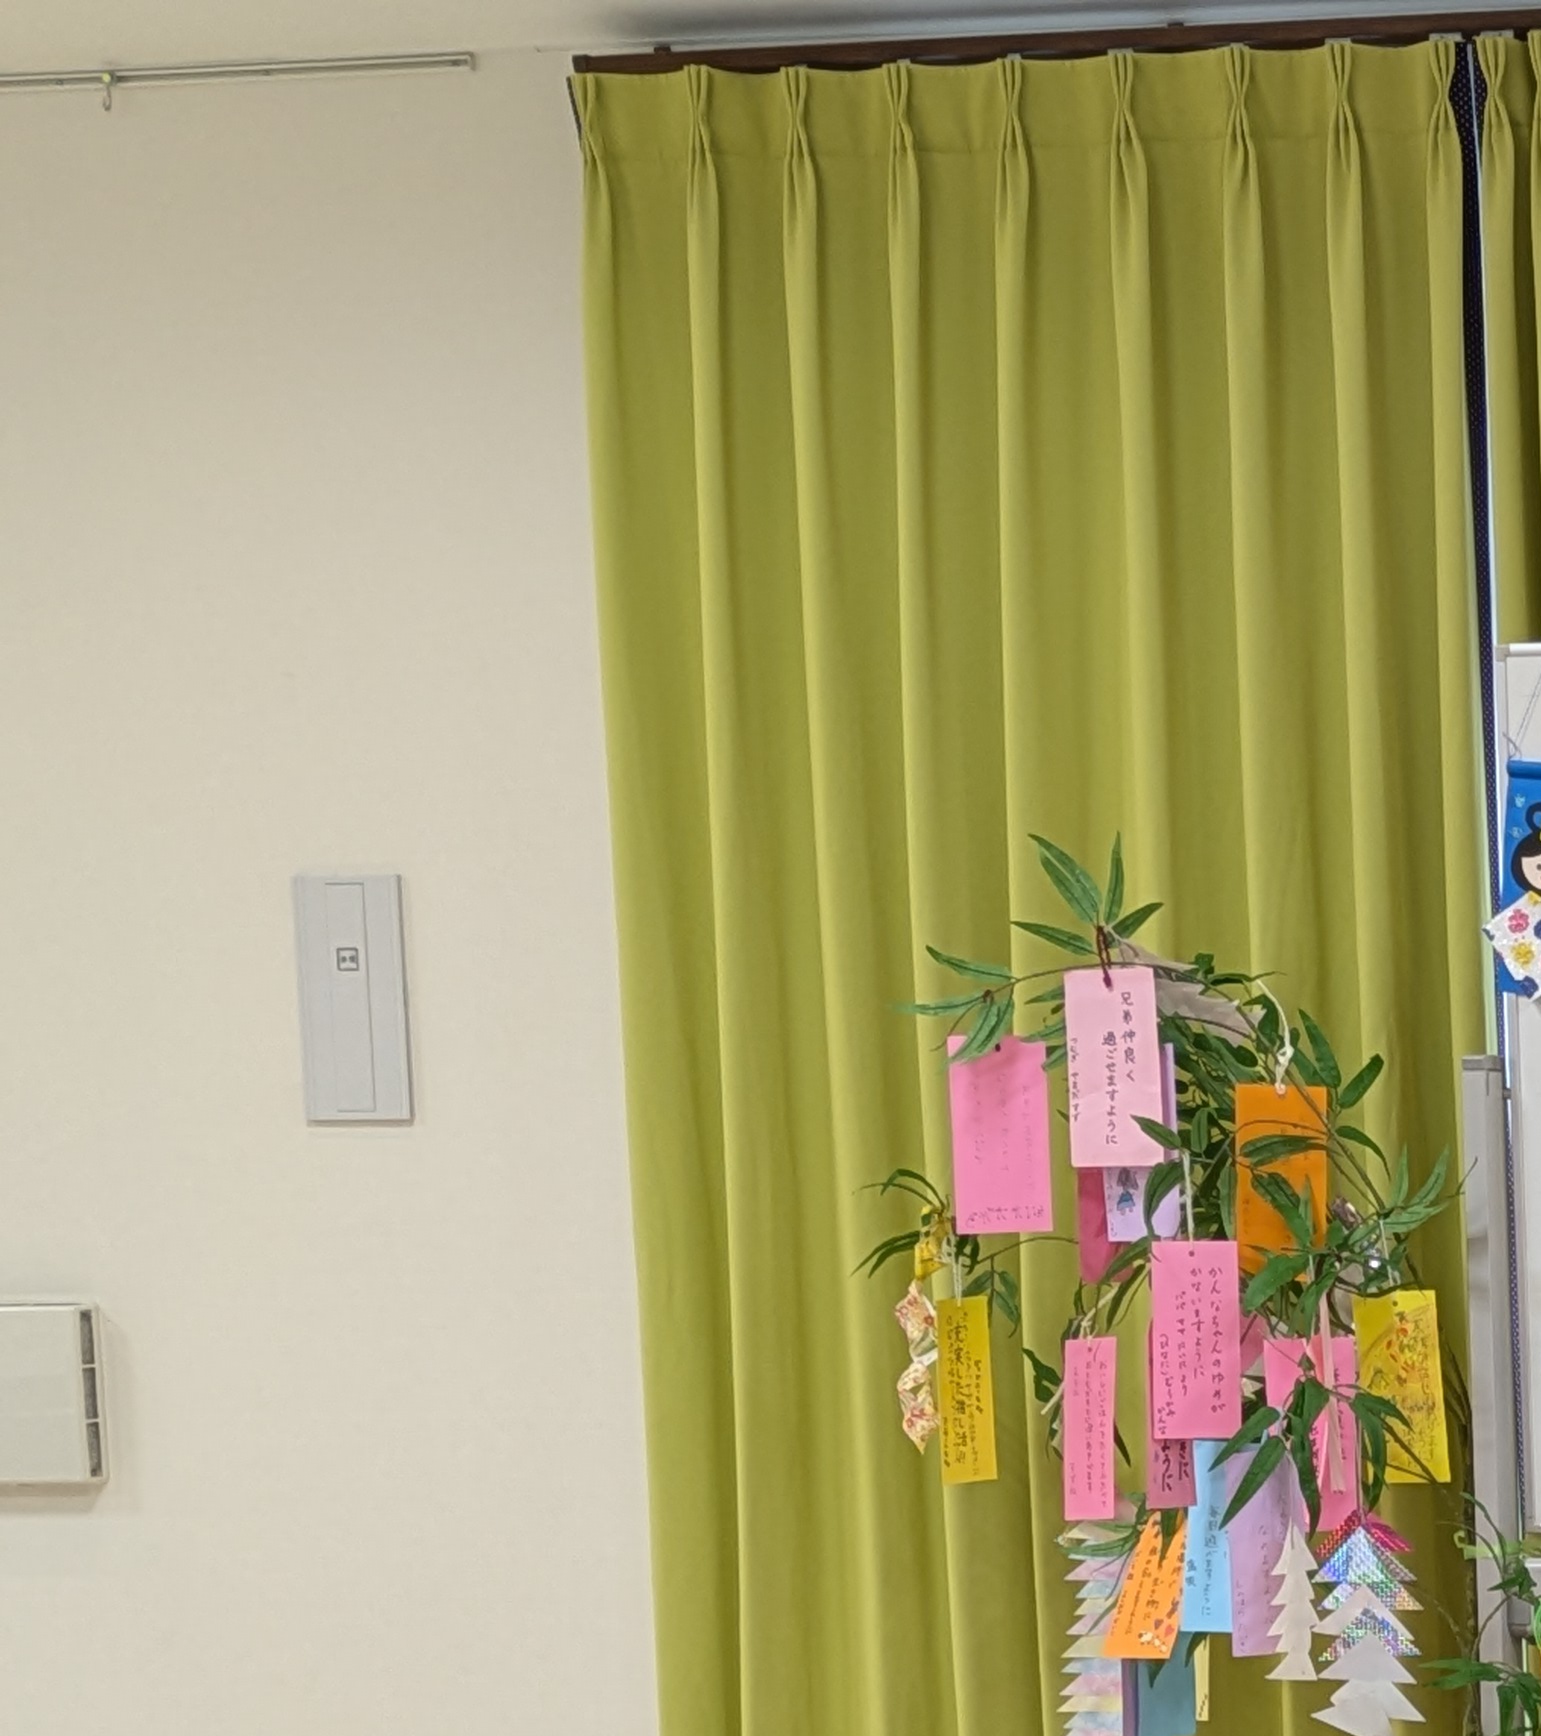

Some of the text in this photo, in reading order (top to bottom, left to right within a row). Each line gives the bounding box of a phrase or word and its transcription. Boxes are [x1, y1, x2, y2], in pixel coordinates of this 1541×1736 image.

[1101, 1031, 1119, 1146] 過ごせますように
[1120, 991, 1137, 1083] 兄弟仲良く
[1208, 1266, 1226, 1414] かんなちゃんのゆめが
